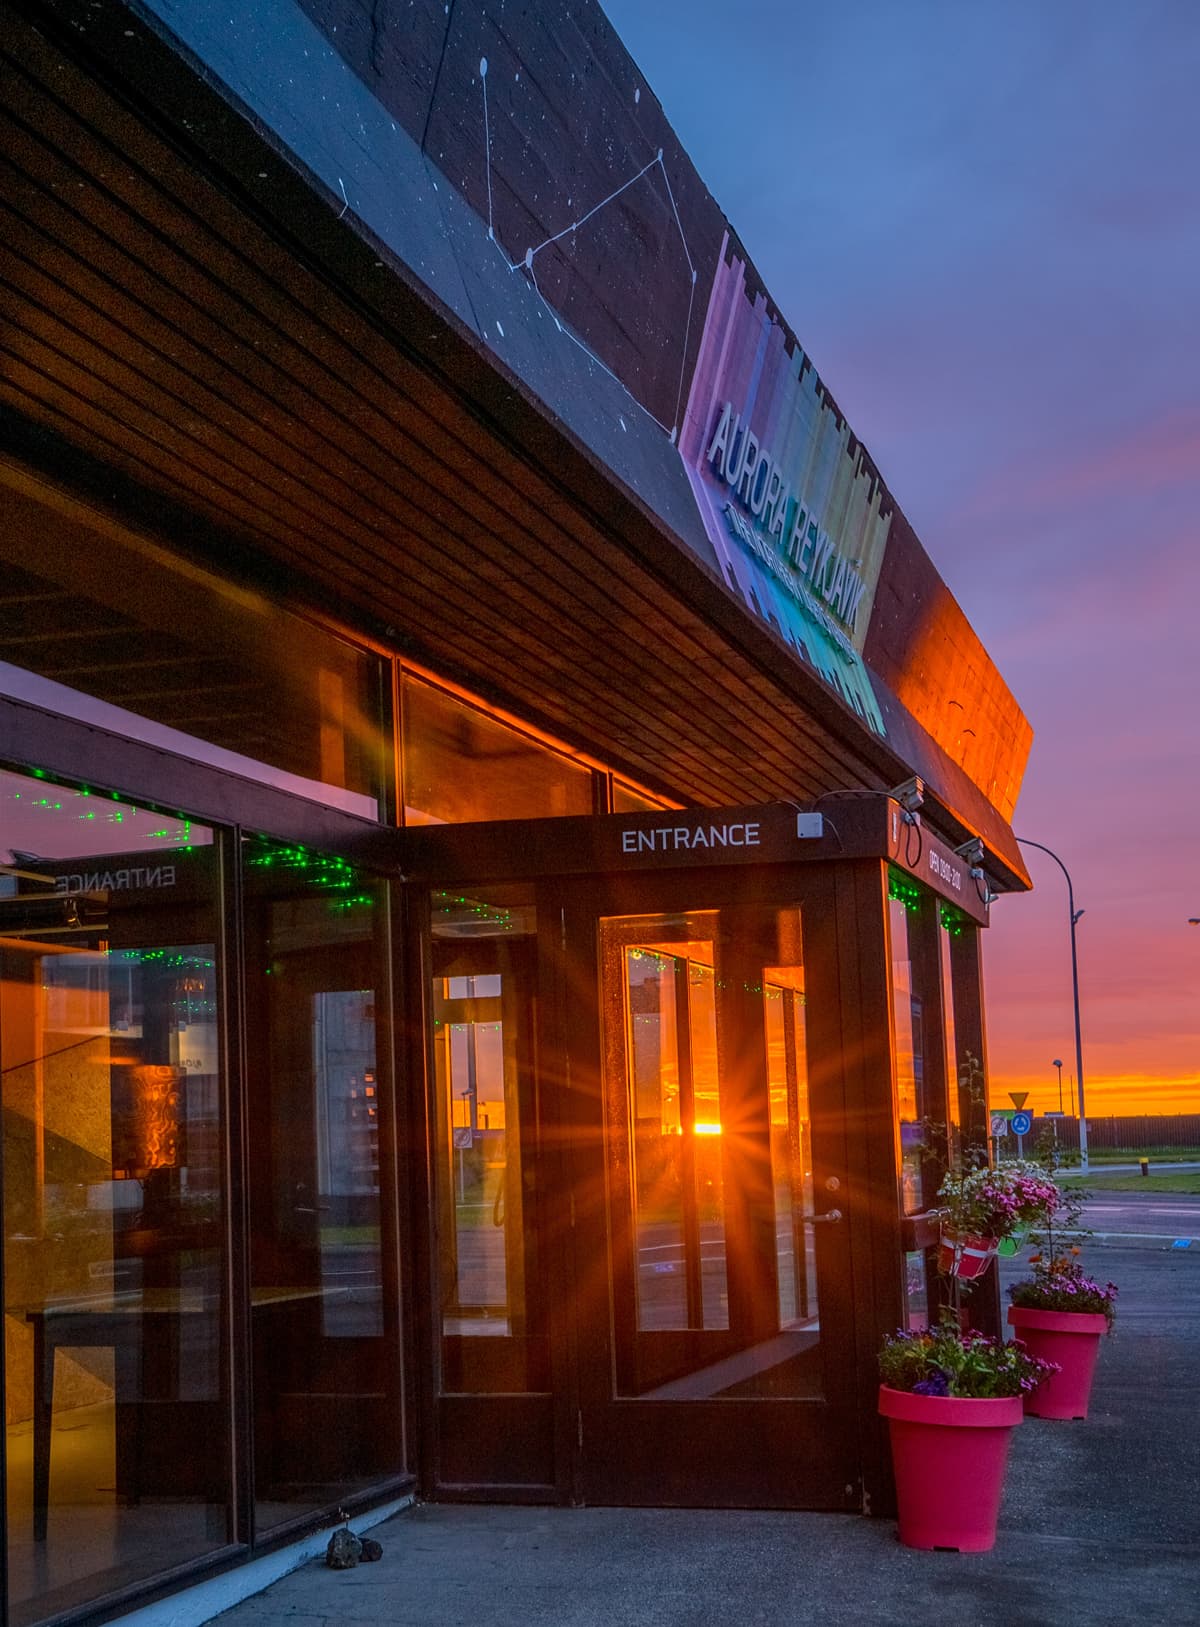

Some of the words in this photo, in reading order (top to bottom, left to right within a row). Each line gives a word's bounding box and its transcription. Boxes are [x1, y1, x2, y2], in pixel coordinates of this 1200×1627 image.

[707, 401, 791, 545] AURORA
[622, 823, 761, 854] ENTRANCE
[929, 849, 940, 874] OPEN
